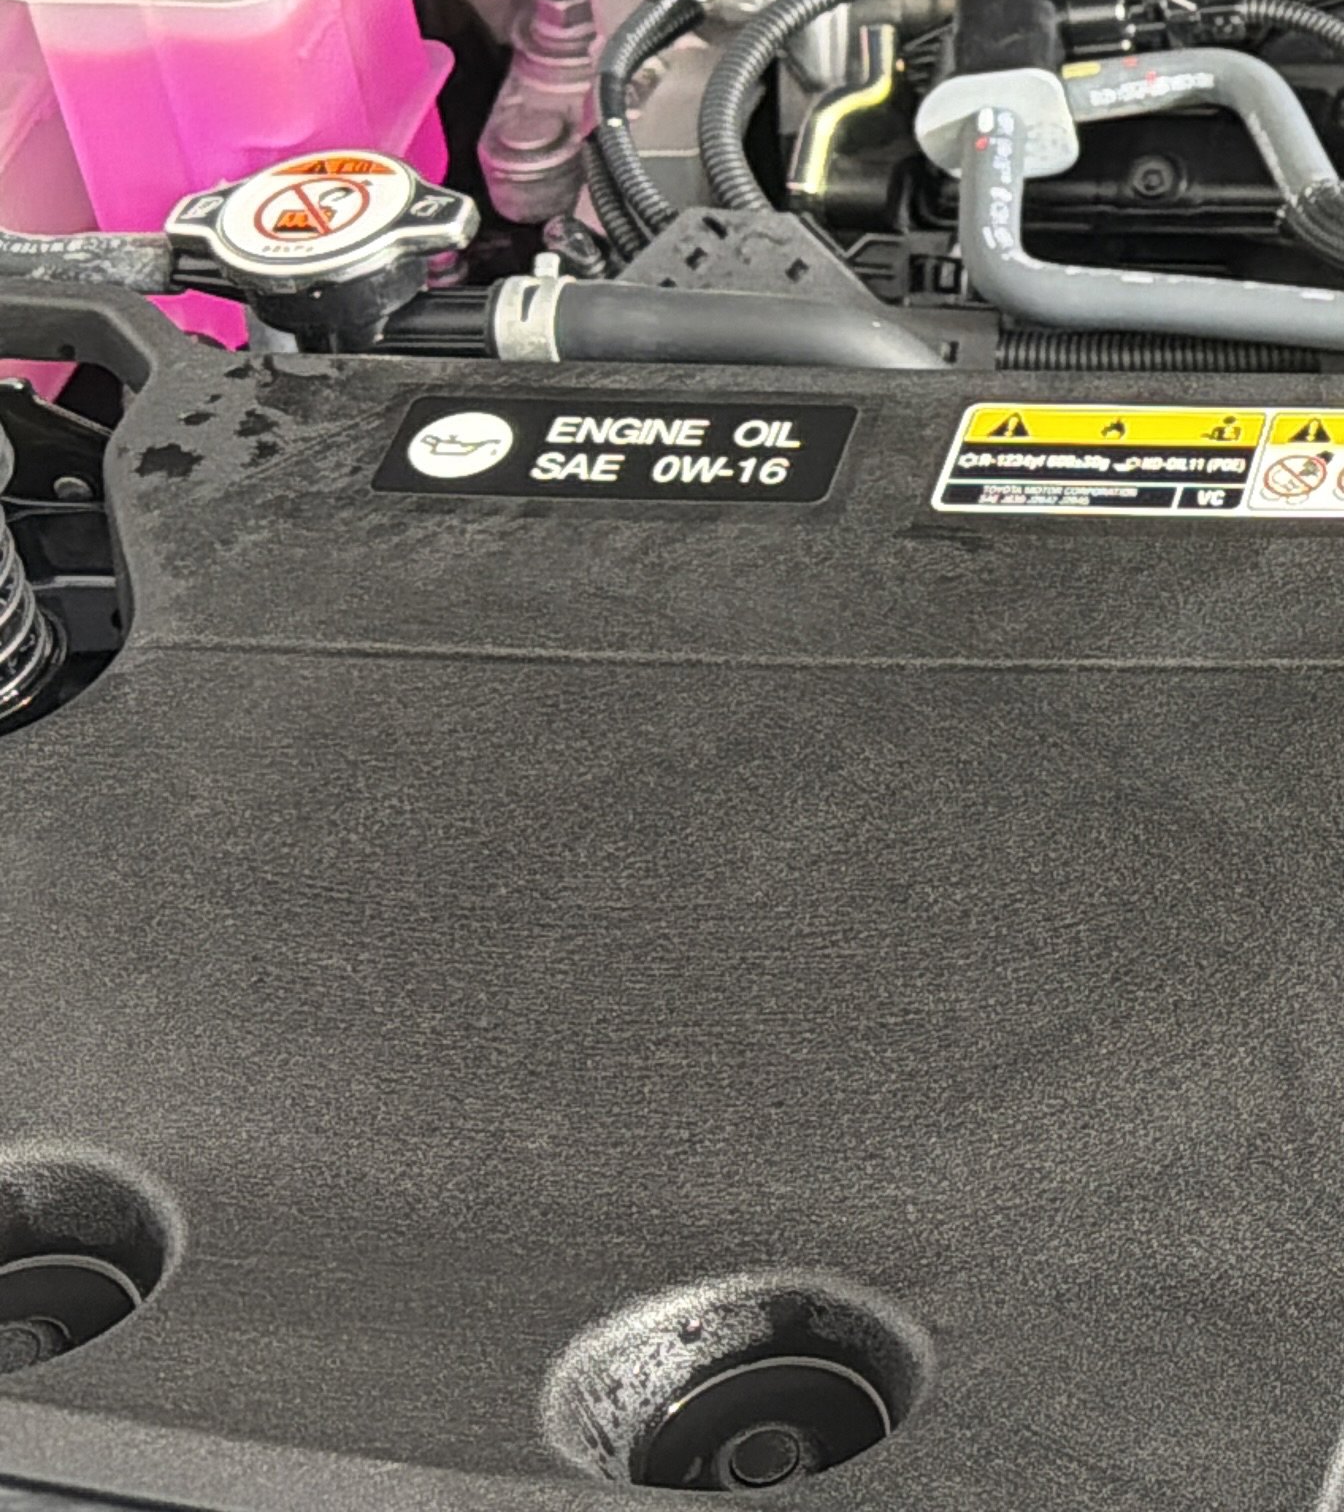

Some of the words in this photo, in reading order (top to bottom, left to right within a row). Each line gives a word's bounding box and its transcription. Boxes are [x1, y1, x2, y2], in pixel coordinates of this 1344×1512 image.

[545, 416, 710, 446] ENGINE
[733, 419, 802, 448] OIL
[530, 451, 625, 481] SAE
[652, 454, 791, 485] 0W-16
[982, 484, 1022, 494] TOYOTA
[1024, 485, 1062, 495] MOTOR
[1063, 486, 1138, 497] CORPORATION
[1196, 489, 1226, 507] VC
